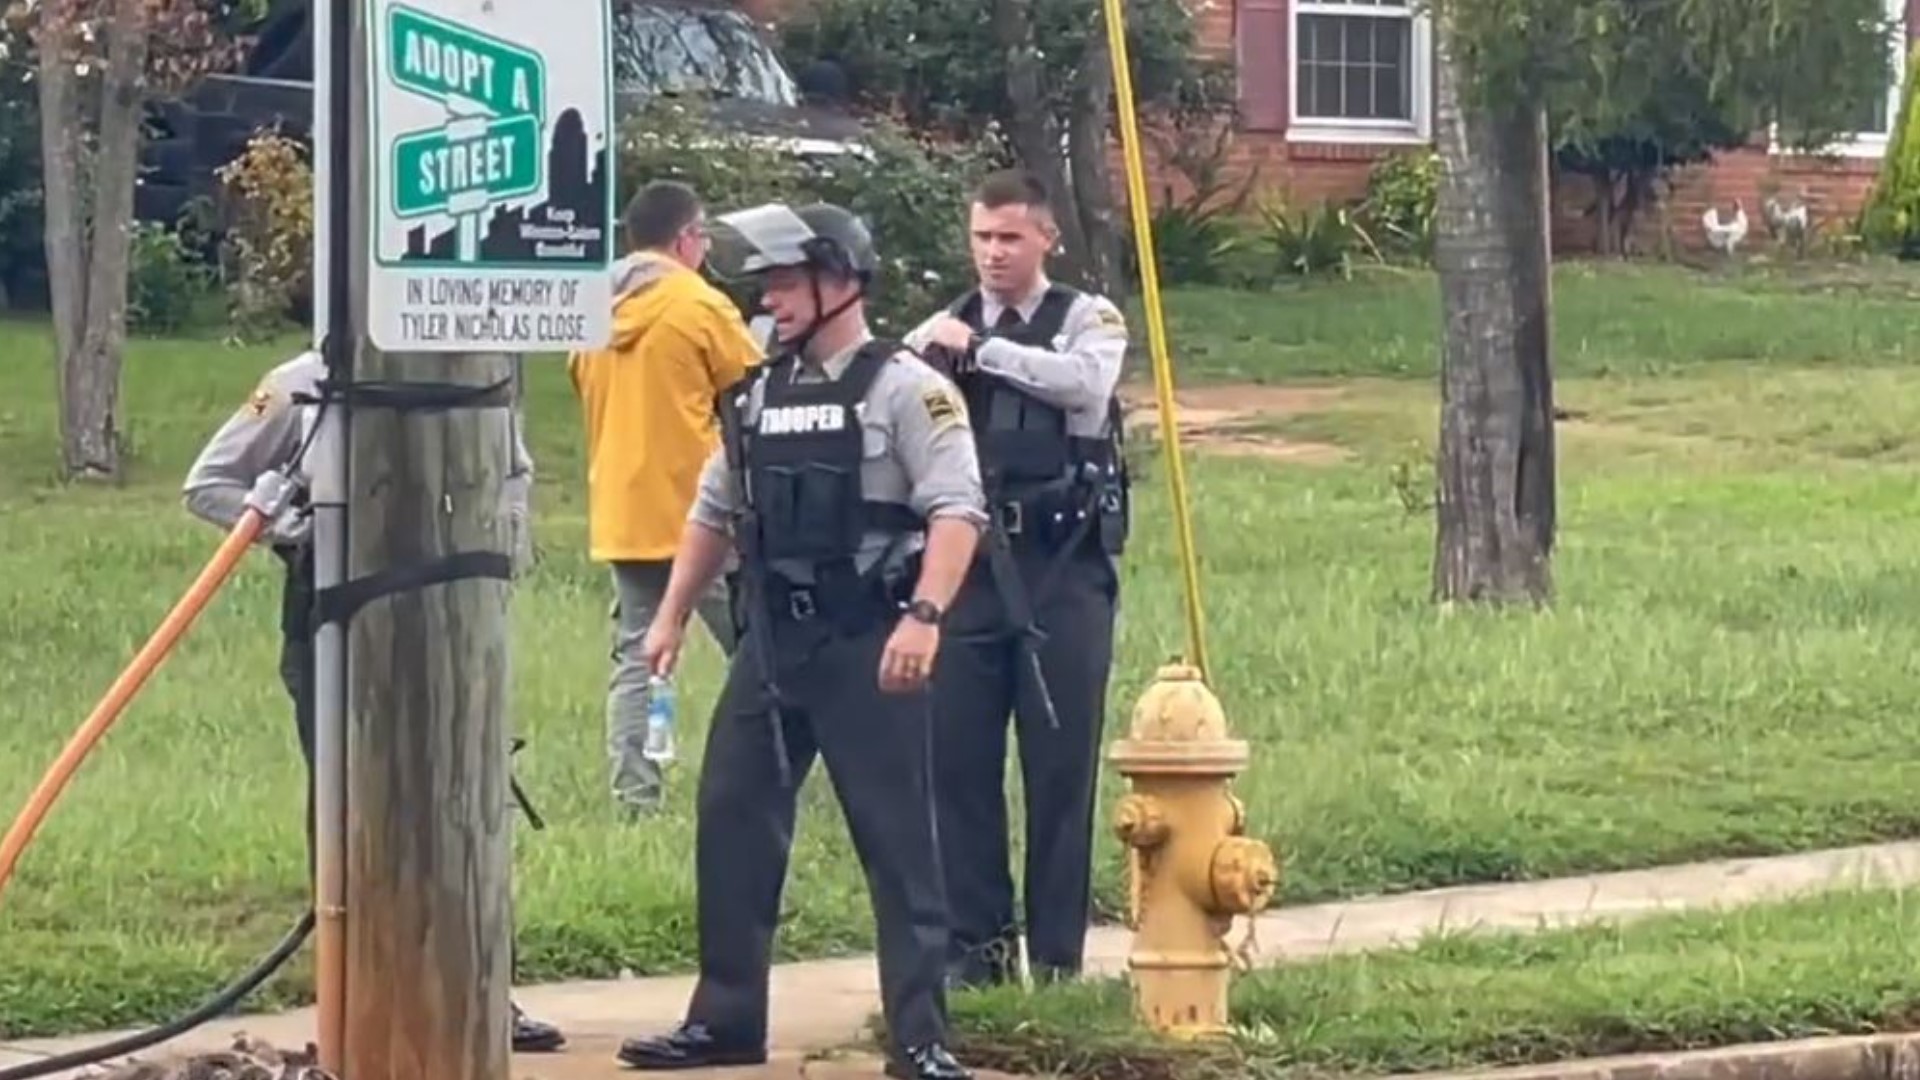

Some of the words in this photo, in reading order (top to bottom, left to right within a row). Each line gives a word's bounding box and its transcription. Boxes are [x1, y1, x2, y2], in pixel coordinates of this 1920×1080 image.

[404, 29, 495, 101] ADOPT
[511, 67, 530, 112] A
[418, 135, 515, 196] STREET
[407, 278, 423, 304] IN
[428, 278, 482, 305] LOVING
[489, 279, 552, 306] MEMORY
[560, 279, 579, 306] OF
[401, 312, 448, 341] TYLER
[455, 312, 530, 341] NICHOLAS
[537, 313, 586, 342] CLOSE
